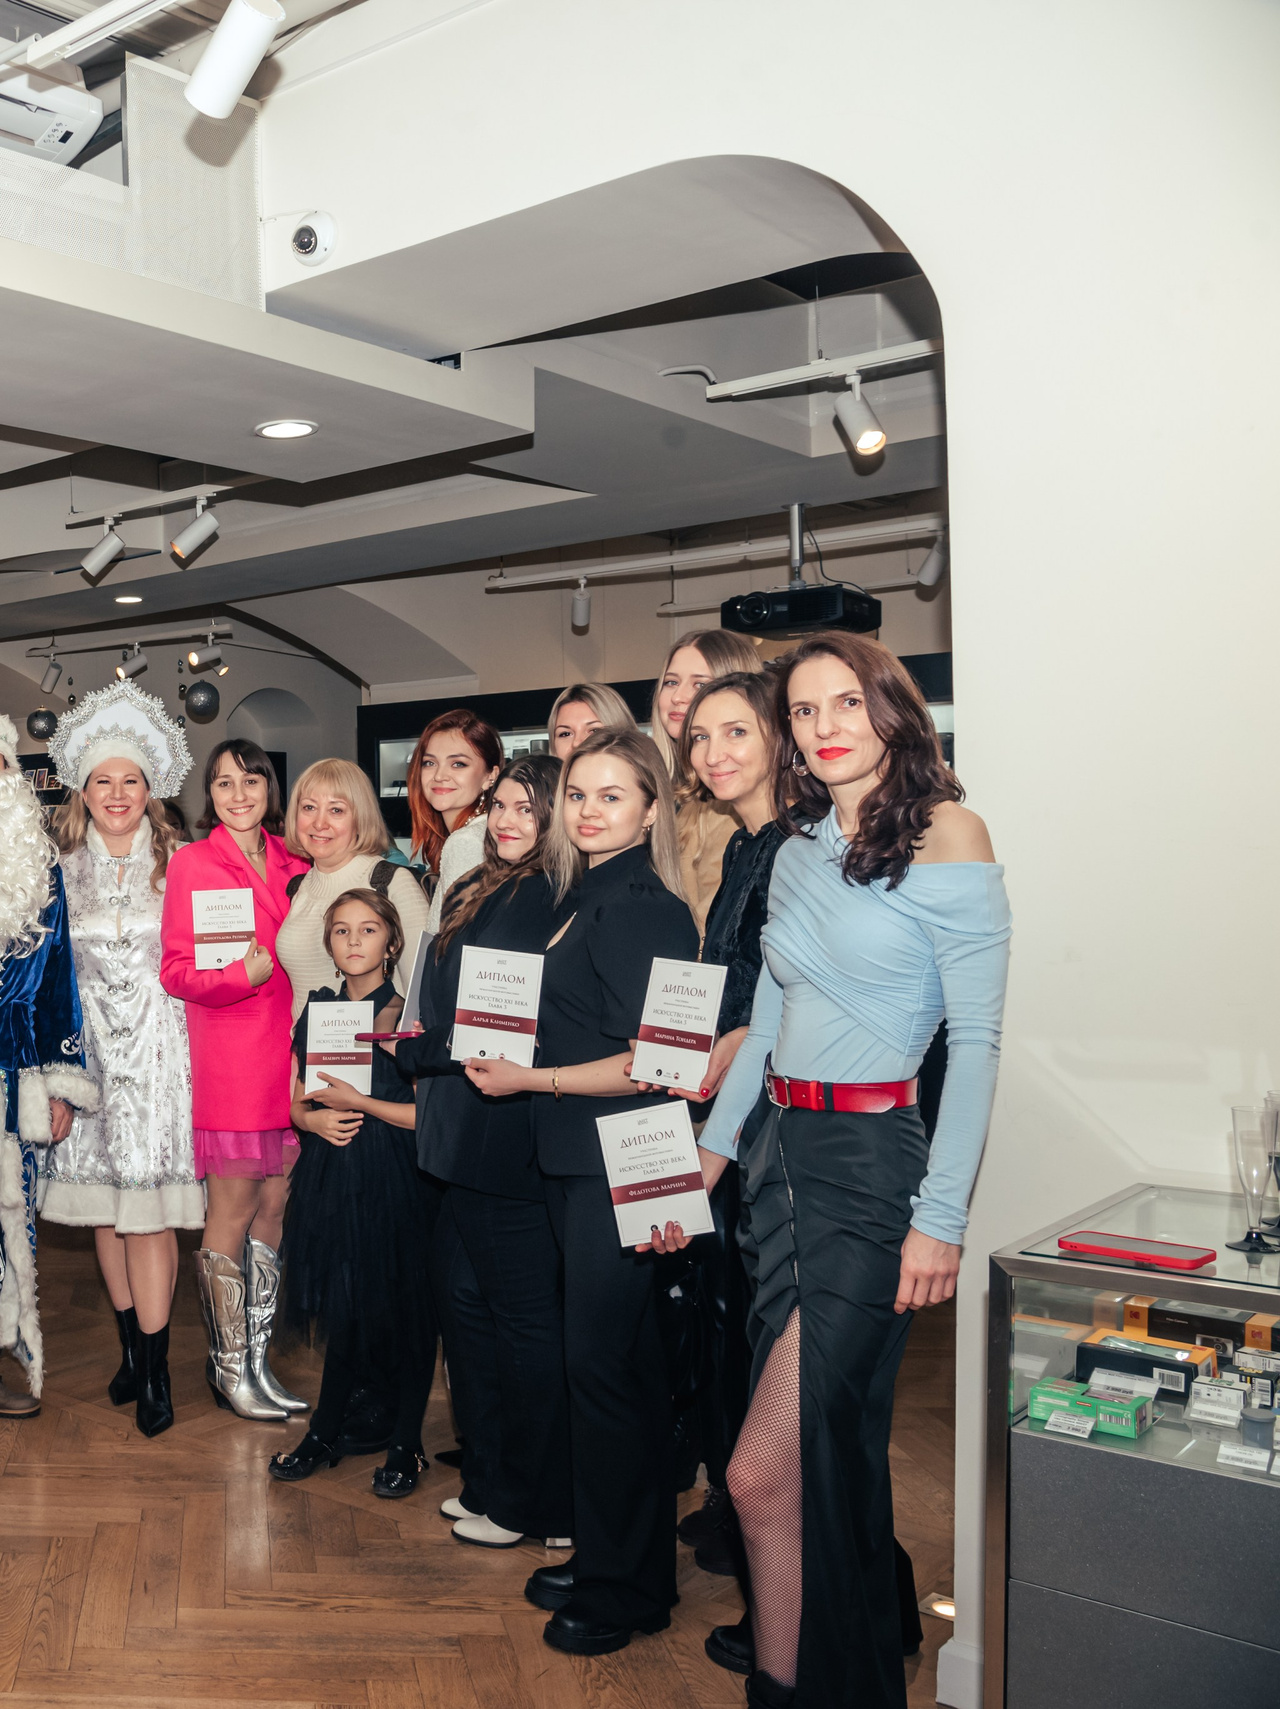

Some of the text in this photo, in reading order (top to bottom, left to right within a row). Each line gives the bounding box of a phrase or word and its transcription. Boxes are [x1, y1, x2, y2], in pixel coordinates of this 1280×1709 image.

[205, 903, 243, 912] ДИПЛОМ
[476, 970, 526, 985] ДИПЛОМ
[661, 983, 707, 999] ДИПЛОМ
[468, 993, 504, 1004] ИСКУССТВО
[514, 999, 529, 1007] ВЕКА
[652, 1008, 685, 1019] ИСКУССТВО
[694, 1014, 707, 1022] ВЕКА
[321, 1019, 361, 1027] ДИПЛОМ
[620, 1129, 676, 1149] ДИПЛОМ
[618, 1160, 658, 1173] ИСКУССТВО
[670, 1155, 687, 1164] ВЕКА
